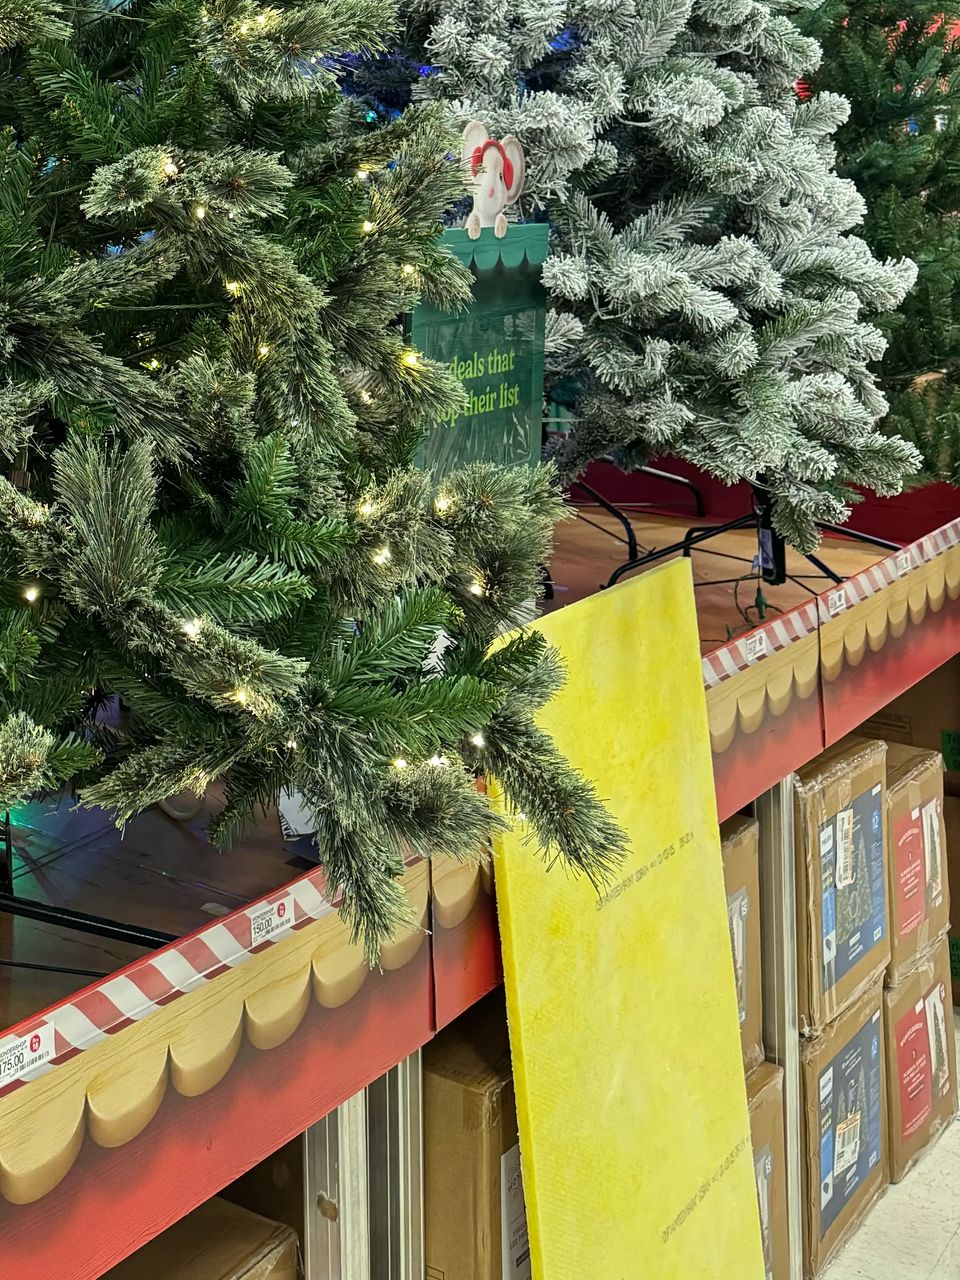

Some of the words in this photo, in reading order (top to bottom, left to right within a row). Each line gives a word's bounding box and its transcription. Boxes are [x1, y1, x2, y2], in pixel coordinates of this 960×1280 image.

[449, 355, 485, 380] deals
[488, 348, 515, 375] that
[499, 382, 520, 409] list
[253, 918, 273, 935] 150.00
